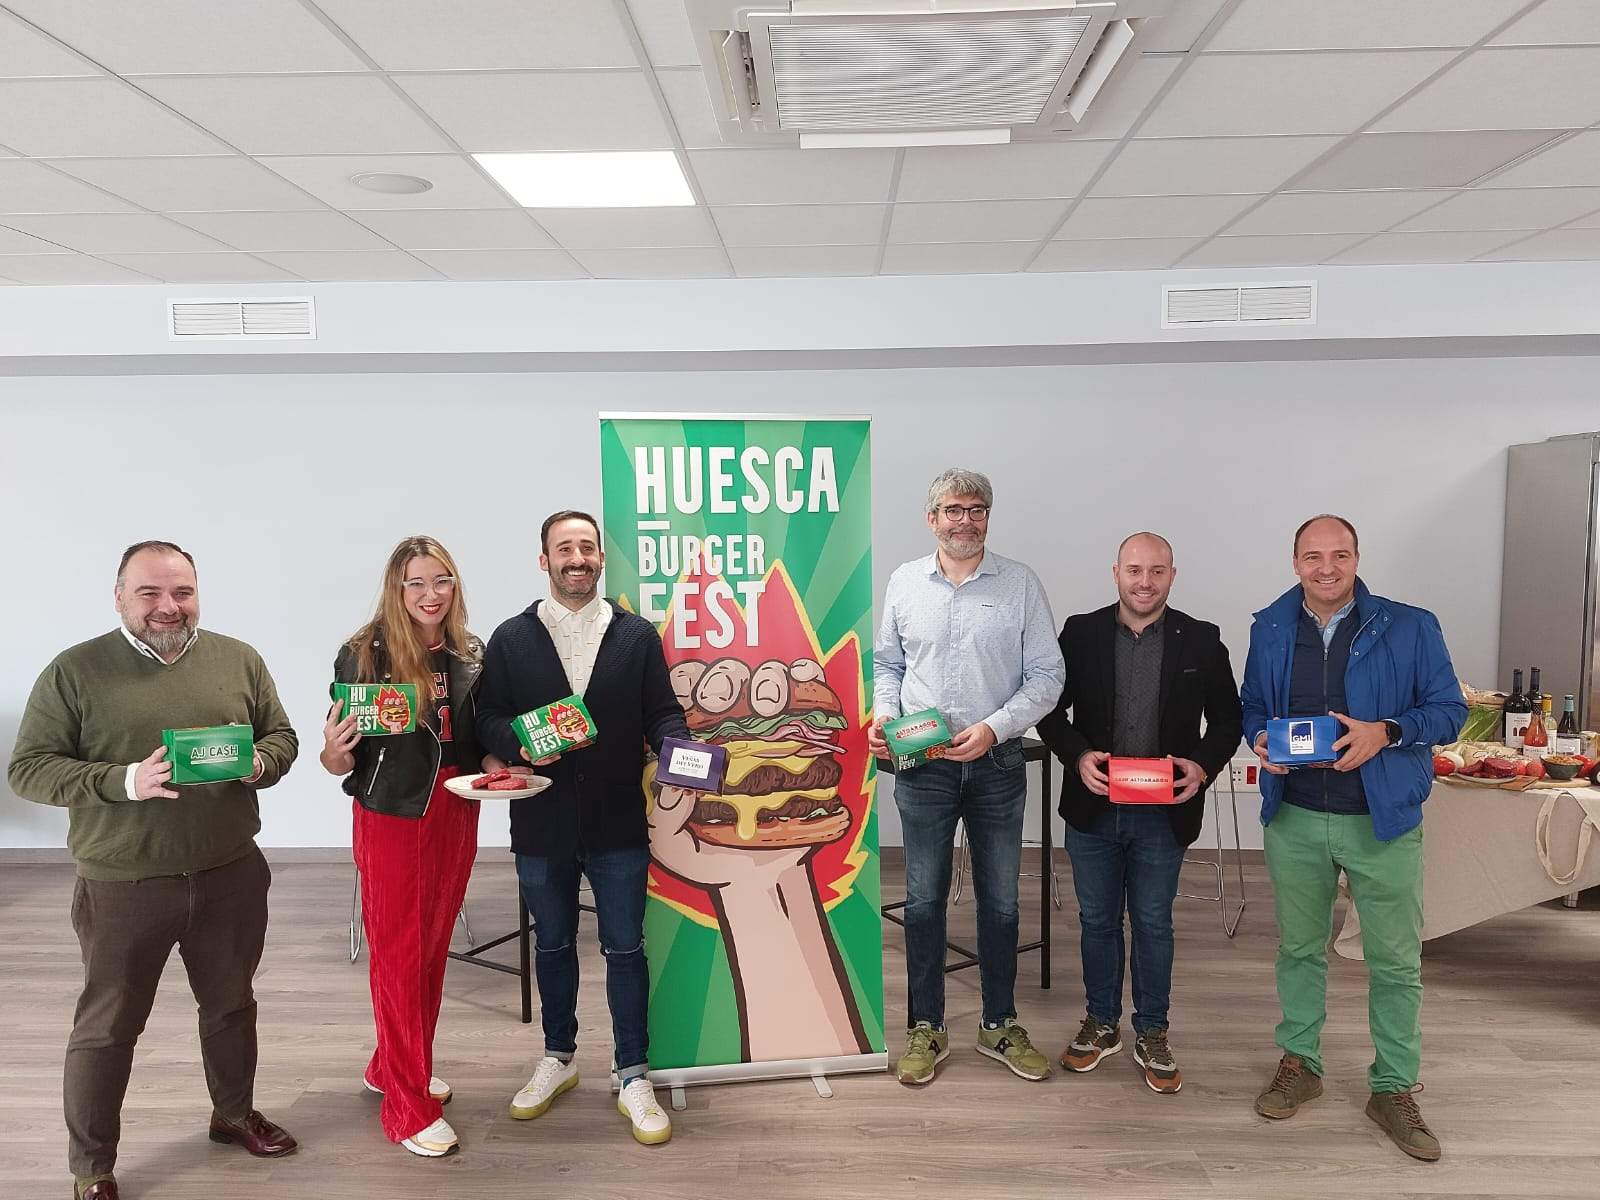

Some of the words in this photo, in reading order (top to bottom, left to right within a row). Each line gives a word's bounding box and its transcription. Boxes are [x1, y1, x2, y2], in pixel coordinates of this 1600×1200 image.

[634, 446, 840, 514] HUESCA
[637, 534, 766, 577] BURGER
[639, 580, 766, 649] FEST
[350, 686, 367, 702] HU
[350, 705, 379, 716] BURGER
[356, 715, 379, 731] EST
[438, 705, 455, 742] 1
[521, 711, 540, 729] HU
[529, 723, 558, 741] BURGER
[190, 746, 206, 760] AJ
[209, 744, 239, 757] CASH
[533, 732, 562, 755] FEST
